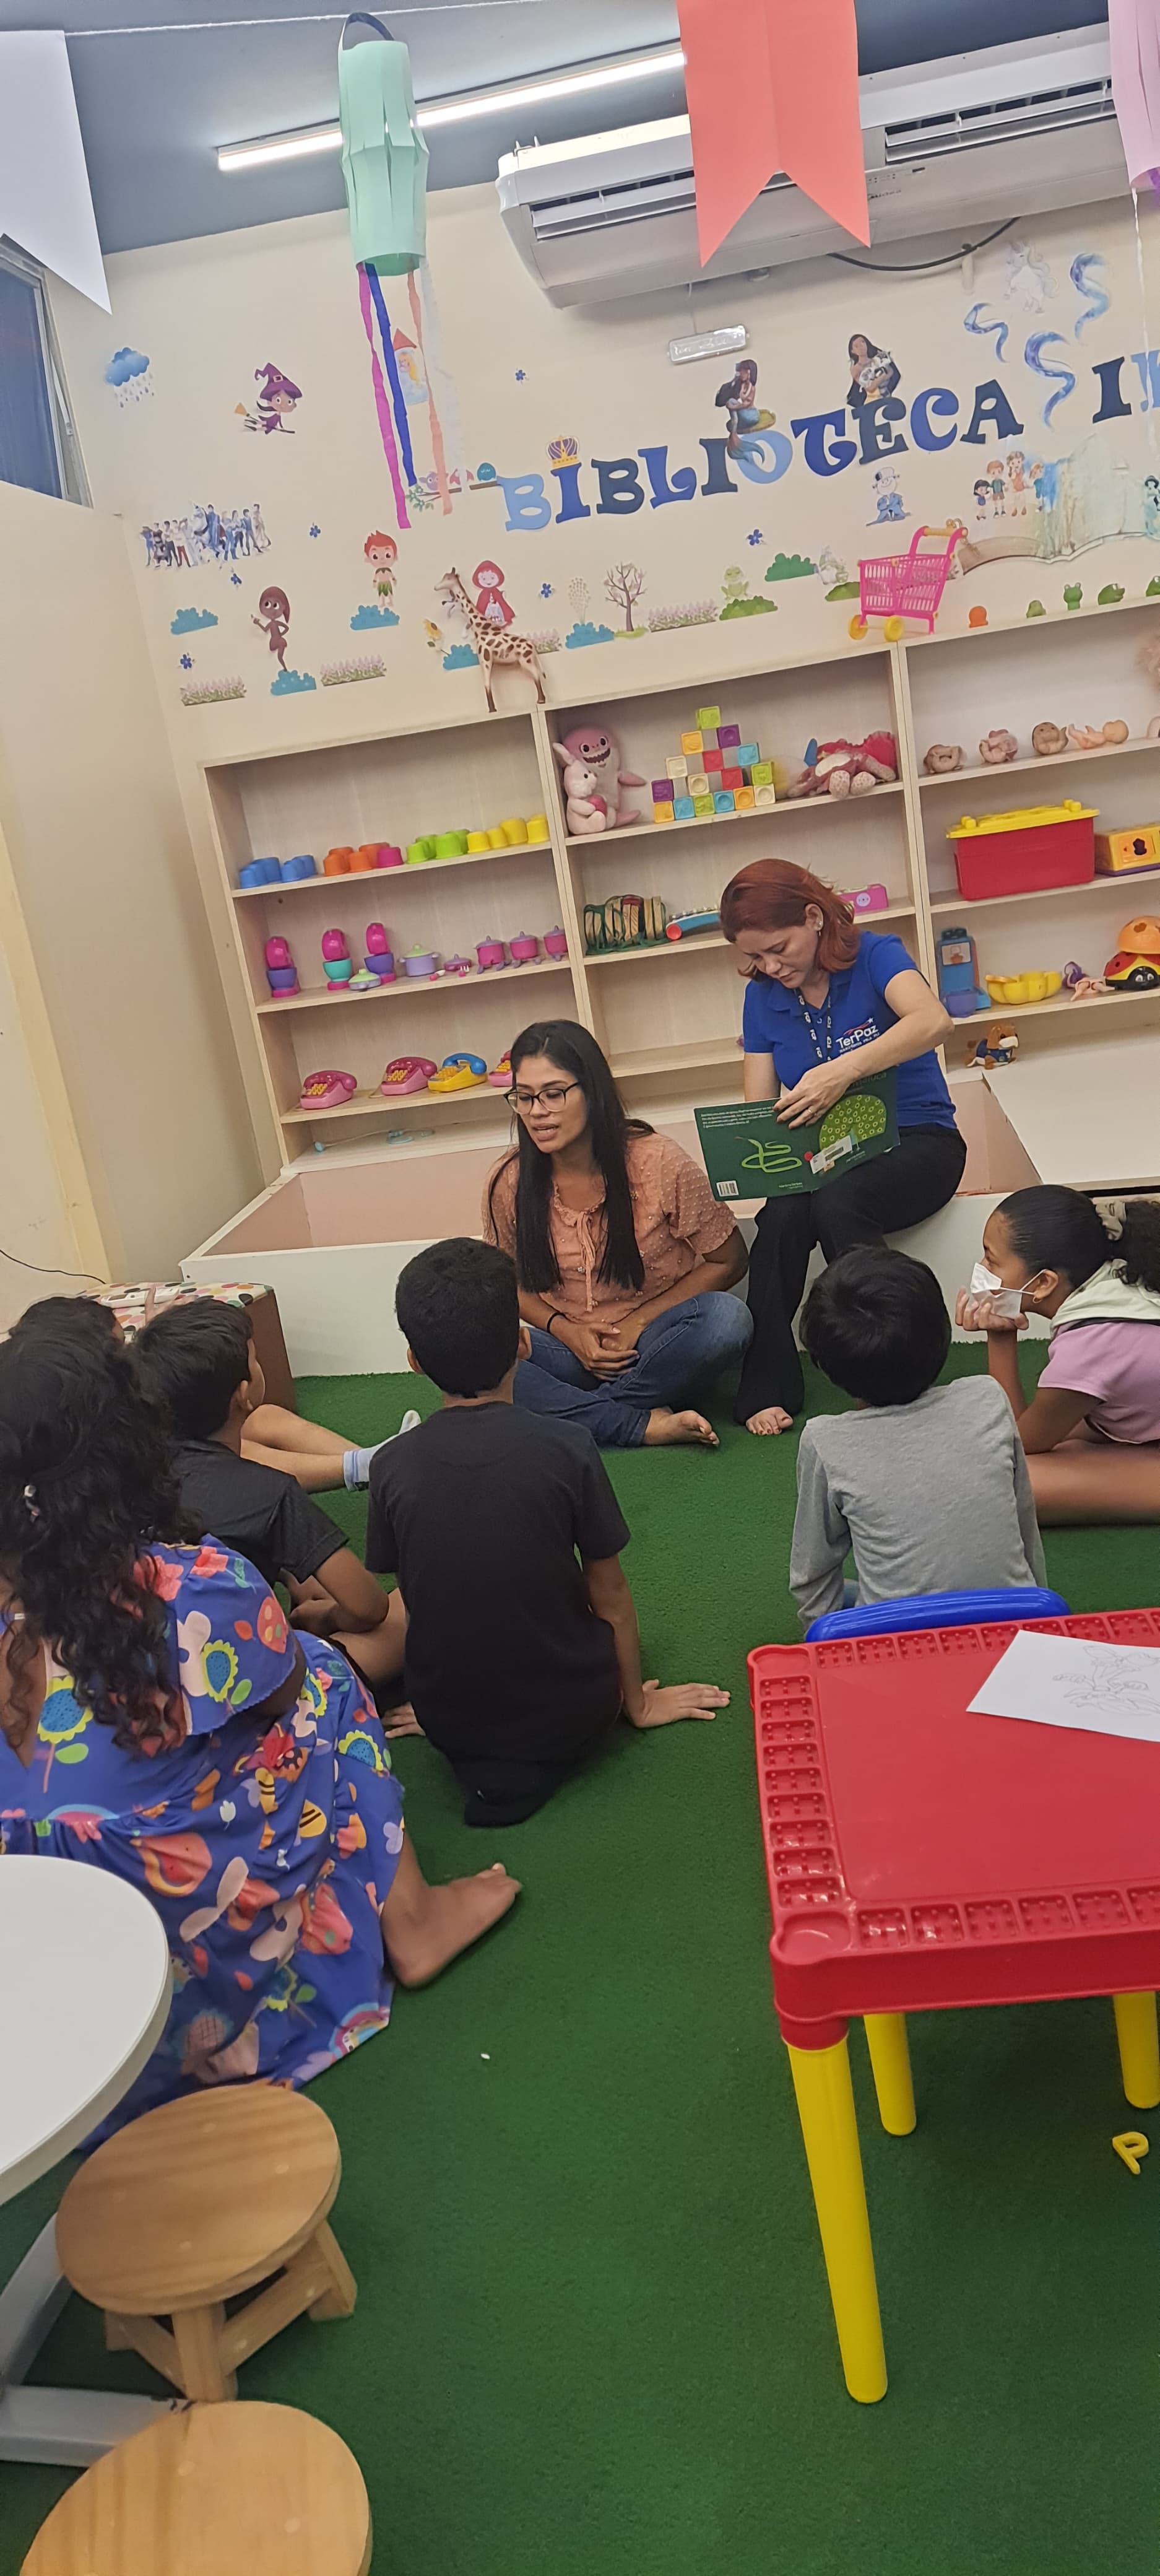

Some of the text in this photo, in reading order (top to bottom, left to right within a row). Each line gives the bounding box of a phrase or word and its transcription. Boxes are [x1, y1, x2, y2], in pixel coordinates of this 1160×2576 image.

[496, 379, 1024, 531] BIBLIOTECA
[836, 1025, 879, 1049] TerPaz
[1112, 2131, 1149, 2175] P
